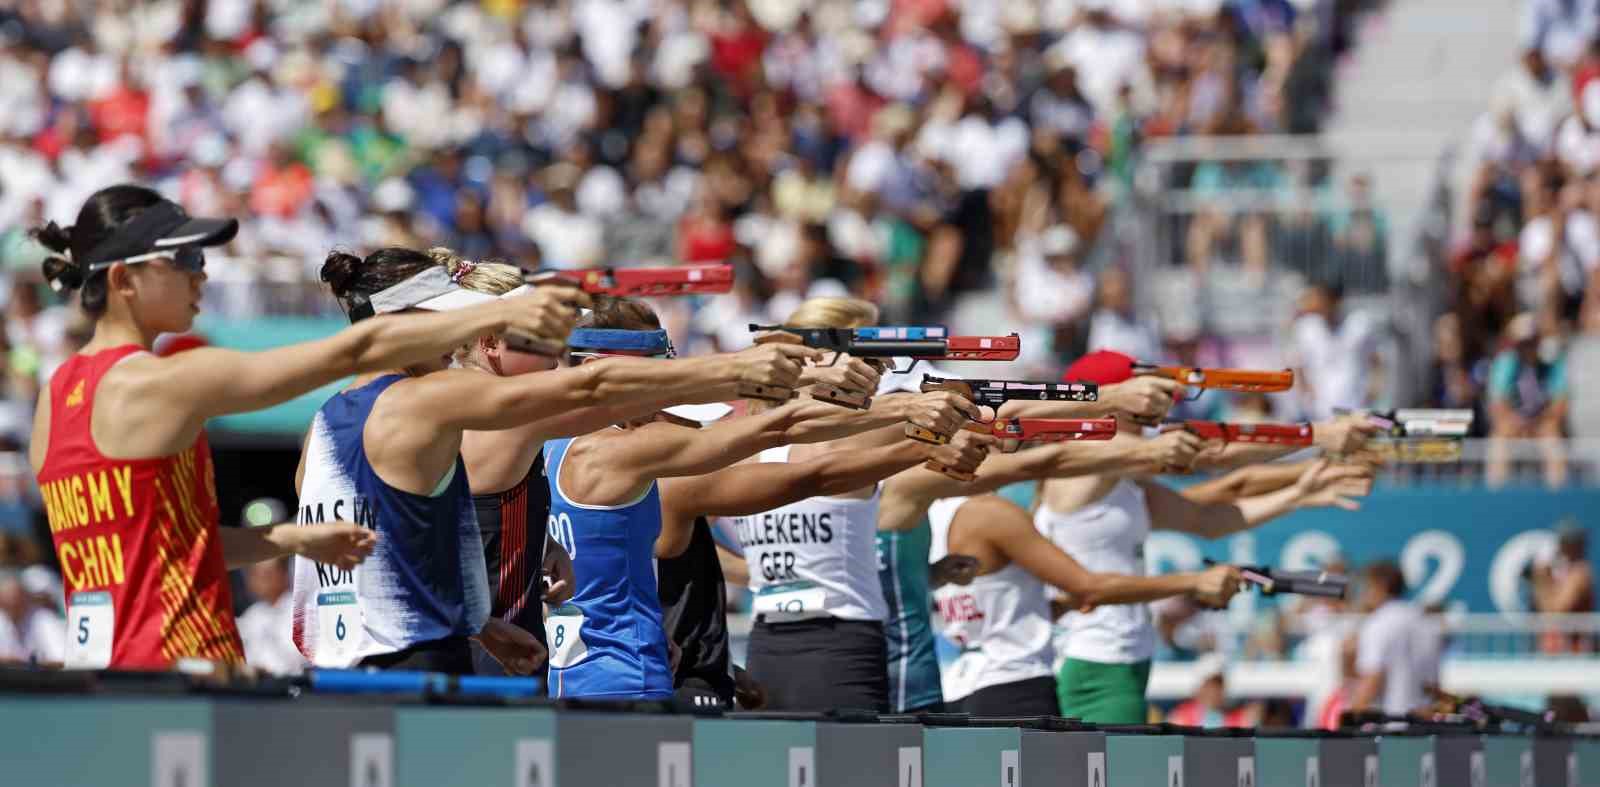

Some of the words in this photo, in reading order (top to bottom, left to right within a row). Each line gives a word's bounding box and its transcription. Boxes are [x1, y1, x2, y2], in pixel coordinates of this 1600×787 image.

[86, 470, 115, 523] M
[112, 464, 134, 517] Y
[60, 533, 124, 592] CHN
[760, 551, 797, 581] GER
[77, 616, 90, 645] 5
[335, 613, 346, 641] 6
[554, 623, 565, 648] 8
